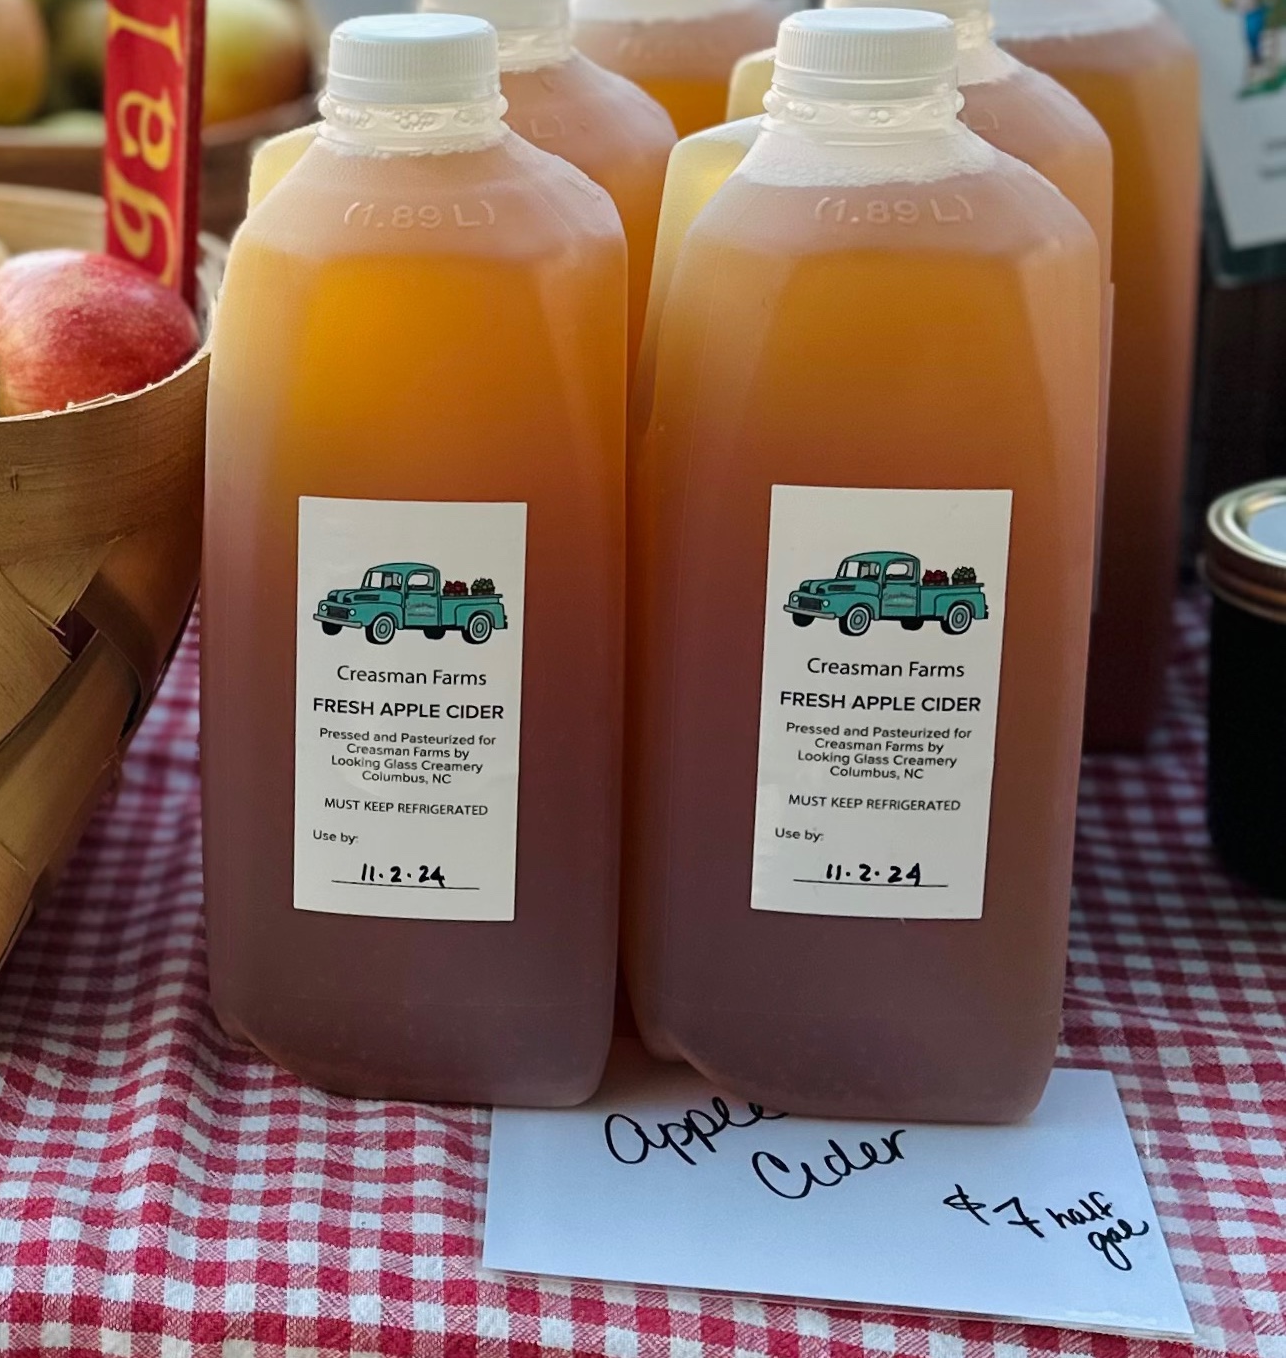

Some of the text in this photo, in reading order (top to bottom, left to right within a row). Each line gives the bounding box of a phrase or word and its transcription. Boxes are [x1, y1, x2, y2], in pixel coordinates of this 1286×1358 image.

[343, 199, 497, 230] (1.89 L)
[815, 194, 975, 225] (1.89 L)
[337, 665, 486, 686] Creasman Farms
[808, 658, 964, 678] Creasman Farms
[314, 698, 503, 720] FRESH APPLE CIDER
[781, 691, 981, 712] FRESH APPLE CIDER
[320, 728, 496, 746] Pressed and Pasteurized for
[787, 722, 972, 739] Pressed and Pasteurized for
[347, 743, 469, 761] Creasman Farms by
[815, 738, 944, 755] Creasman Farms by
[332, 755, 483, 775] Looking Glass Creamery
[798, 750, 957, 769] Looking Glass Creamery
[362, 771, 451, 785] Columbus, NC
[830, 766, 923, 780] Columbus, NC
[325, 798, 488, 816] MUST KEEP REFRIGERATED
[789, 794, 960, 811] MUST KEEP REFRIGERATED
[313, 830, 358, 846] Use by:
[775, 828, 823, 844] Use by:
[752, 1129, 906, 1199] Cider
[1045, 1191, 1113, 1230] half
[1088, 1218, 1149, 1271] gal
